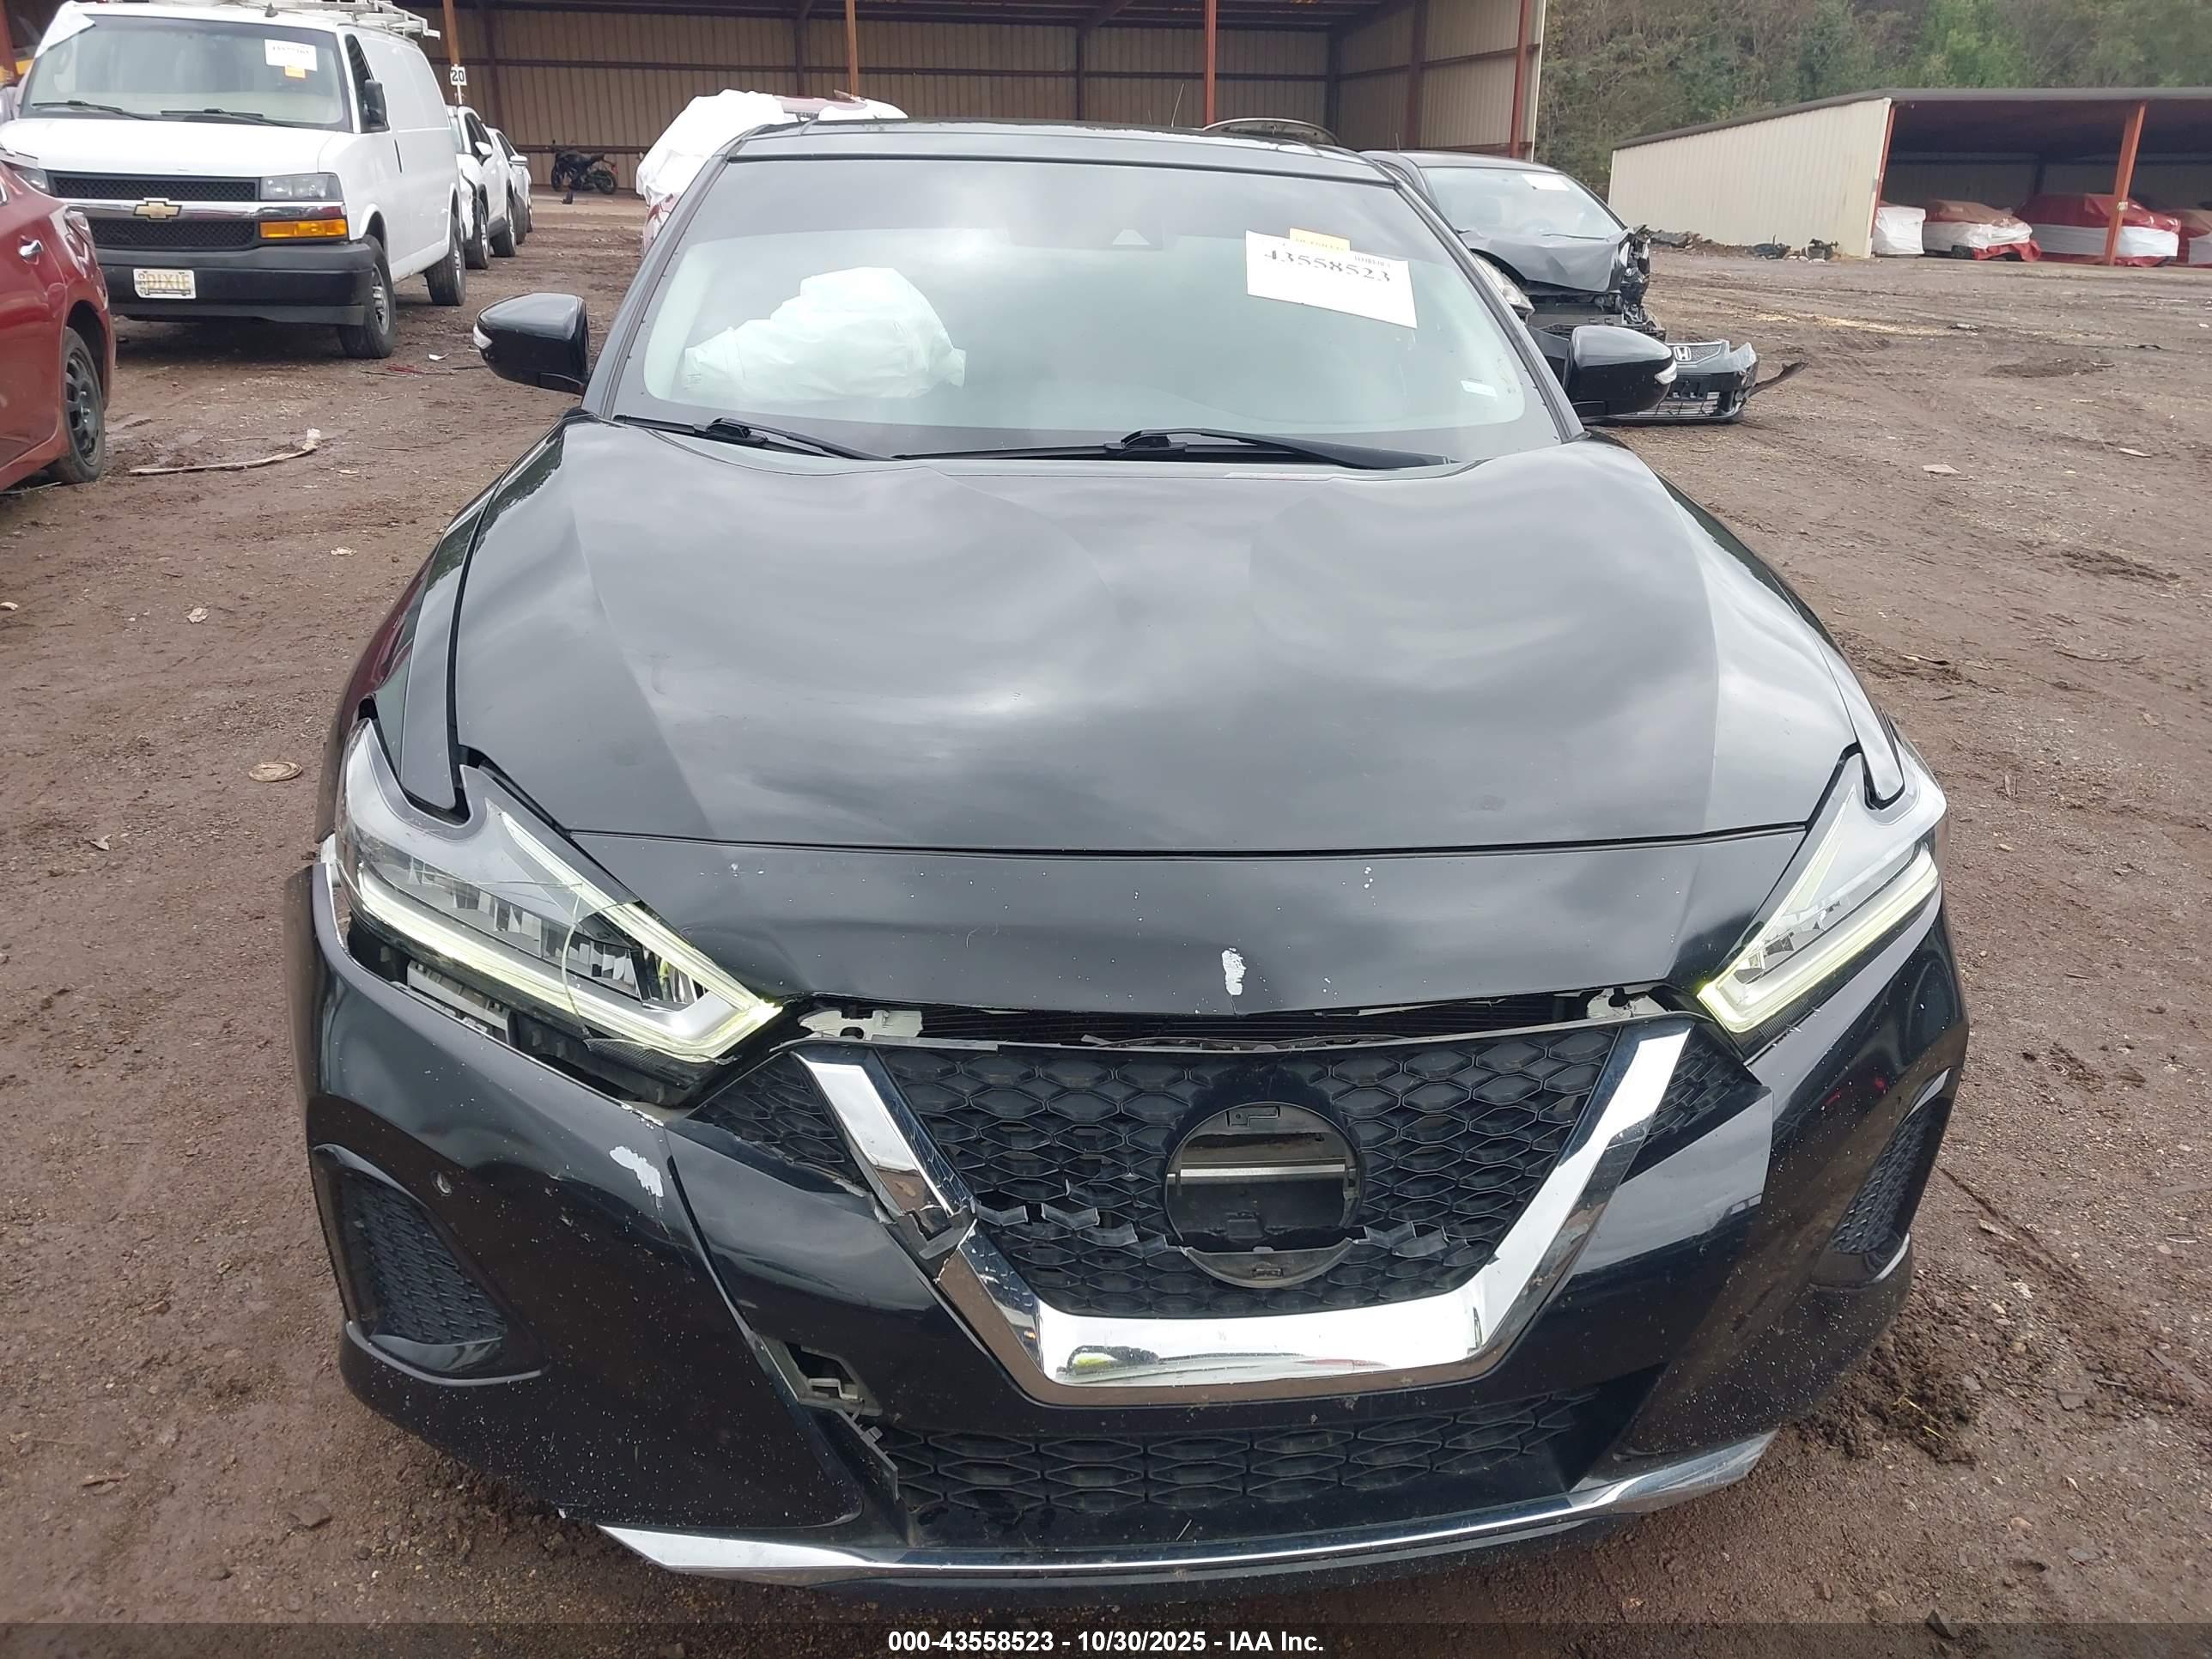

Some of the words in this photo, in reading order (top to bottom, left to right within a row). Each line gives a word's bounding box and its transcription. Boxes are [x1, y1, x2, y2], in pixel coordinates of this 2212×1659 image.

[451, 70, 465, 82] 20
[1264, 249, 1391, 283] 43558523
[146, 273, 190, 289] DIXIE
